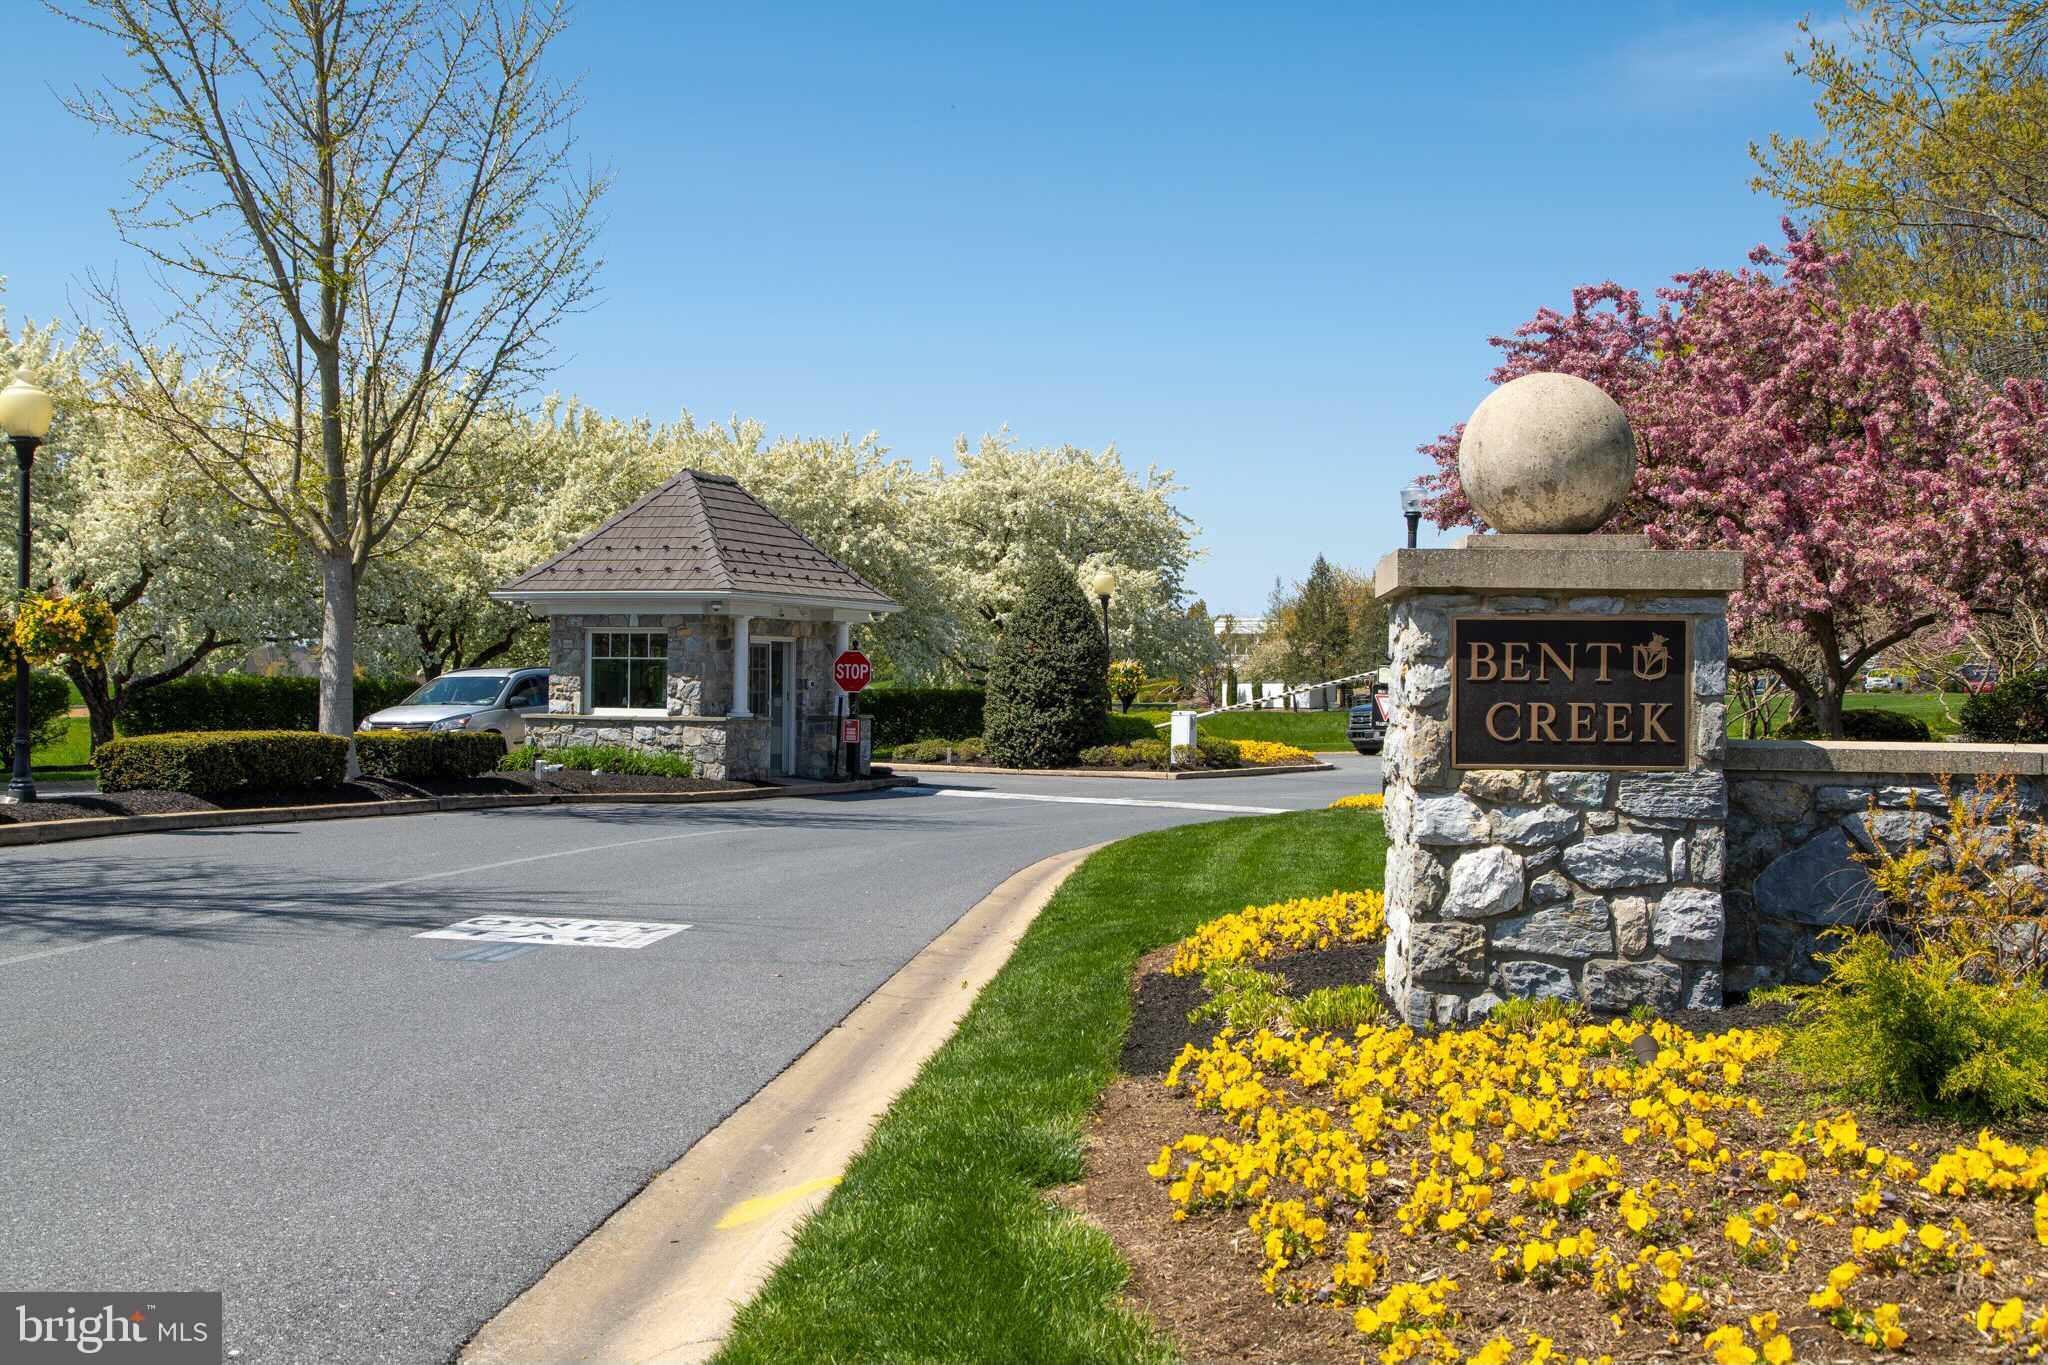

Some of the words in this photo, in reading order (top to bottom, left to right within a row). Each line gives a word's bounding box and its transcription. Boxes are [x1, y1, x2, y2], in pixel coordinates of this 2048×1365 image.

[836, 663, 869, 679] STOP
[1466, 641, 1623, 682] BENT
[1486, 702, 1676, 743] CREEK
